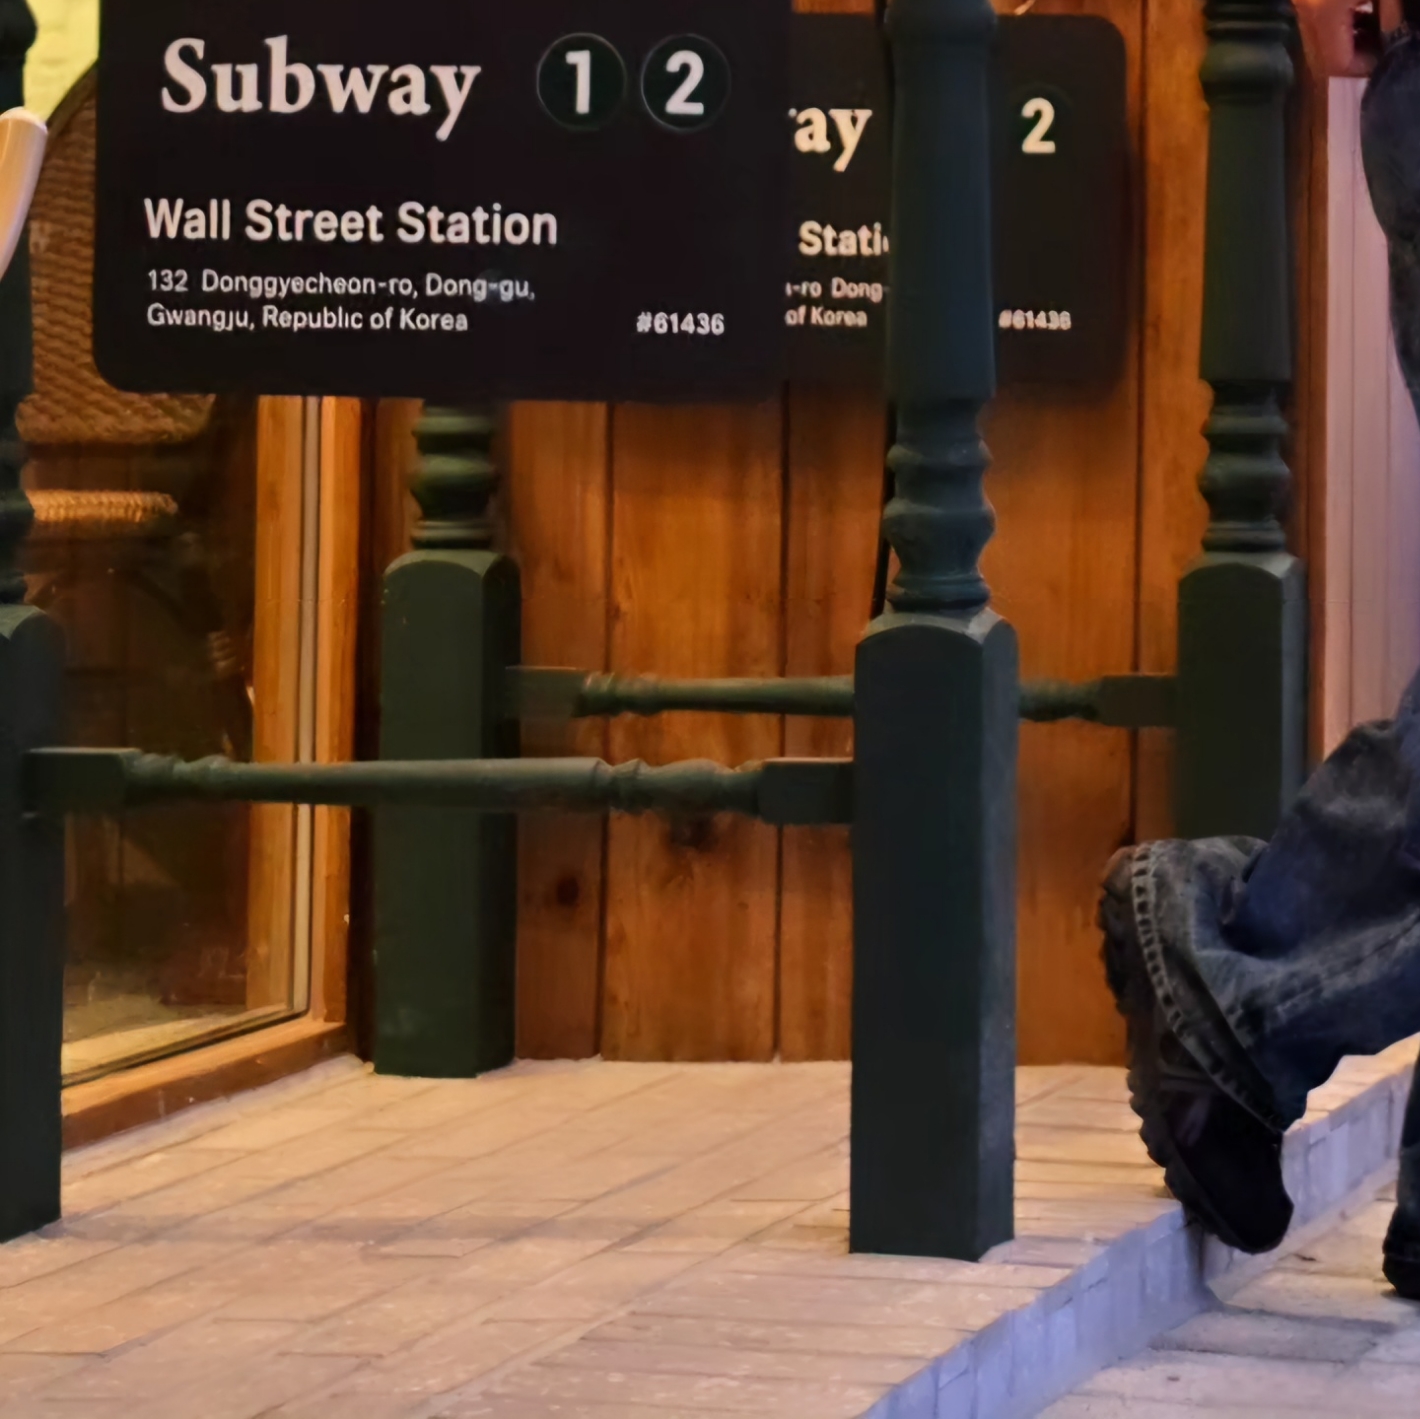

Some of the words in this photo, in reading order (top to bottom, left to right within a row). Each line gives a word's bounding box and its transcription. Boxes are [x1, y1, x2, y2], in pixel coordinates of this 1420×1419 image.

[160, 34, 484, 142] Subway
[564, 49, 592, 115] 1
[664, 49, 706, 116] 2
[787, 106, 874, 173] ay
[1020, 96, 1057, 155] 2
[143, 197, 231, 240] Wall
[245, 198, 386, 243] Street
[396, 201, 558, 246] Station
[147, 268, 190, 293] 132
[424, 272, 537, 302] Dong-gu,
[146, 302, 256, 332] Gwangju,
[262, 304, 364, 332] Republic
[369, 308, 394, 330] of
[399, 309, 469, 332] Korea
[636, 310, 726, 336] #61436
[810, 305, 868, 327] Korea
